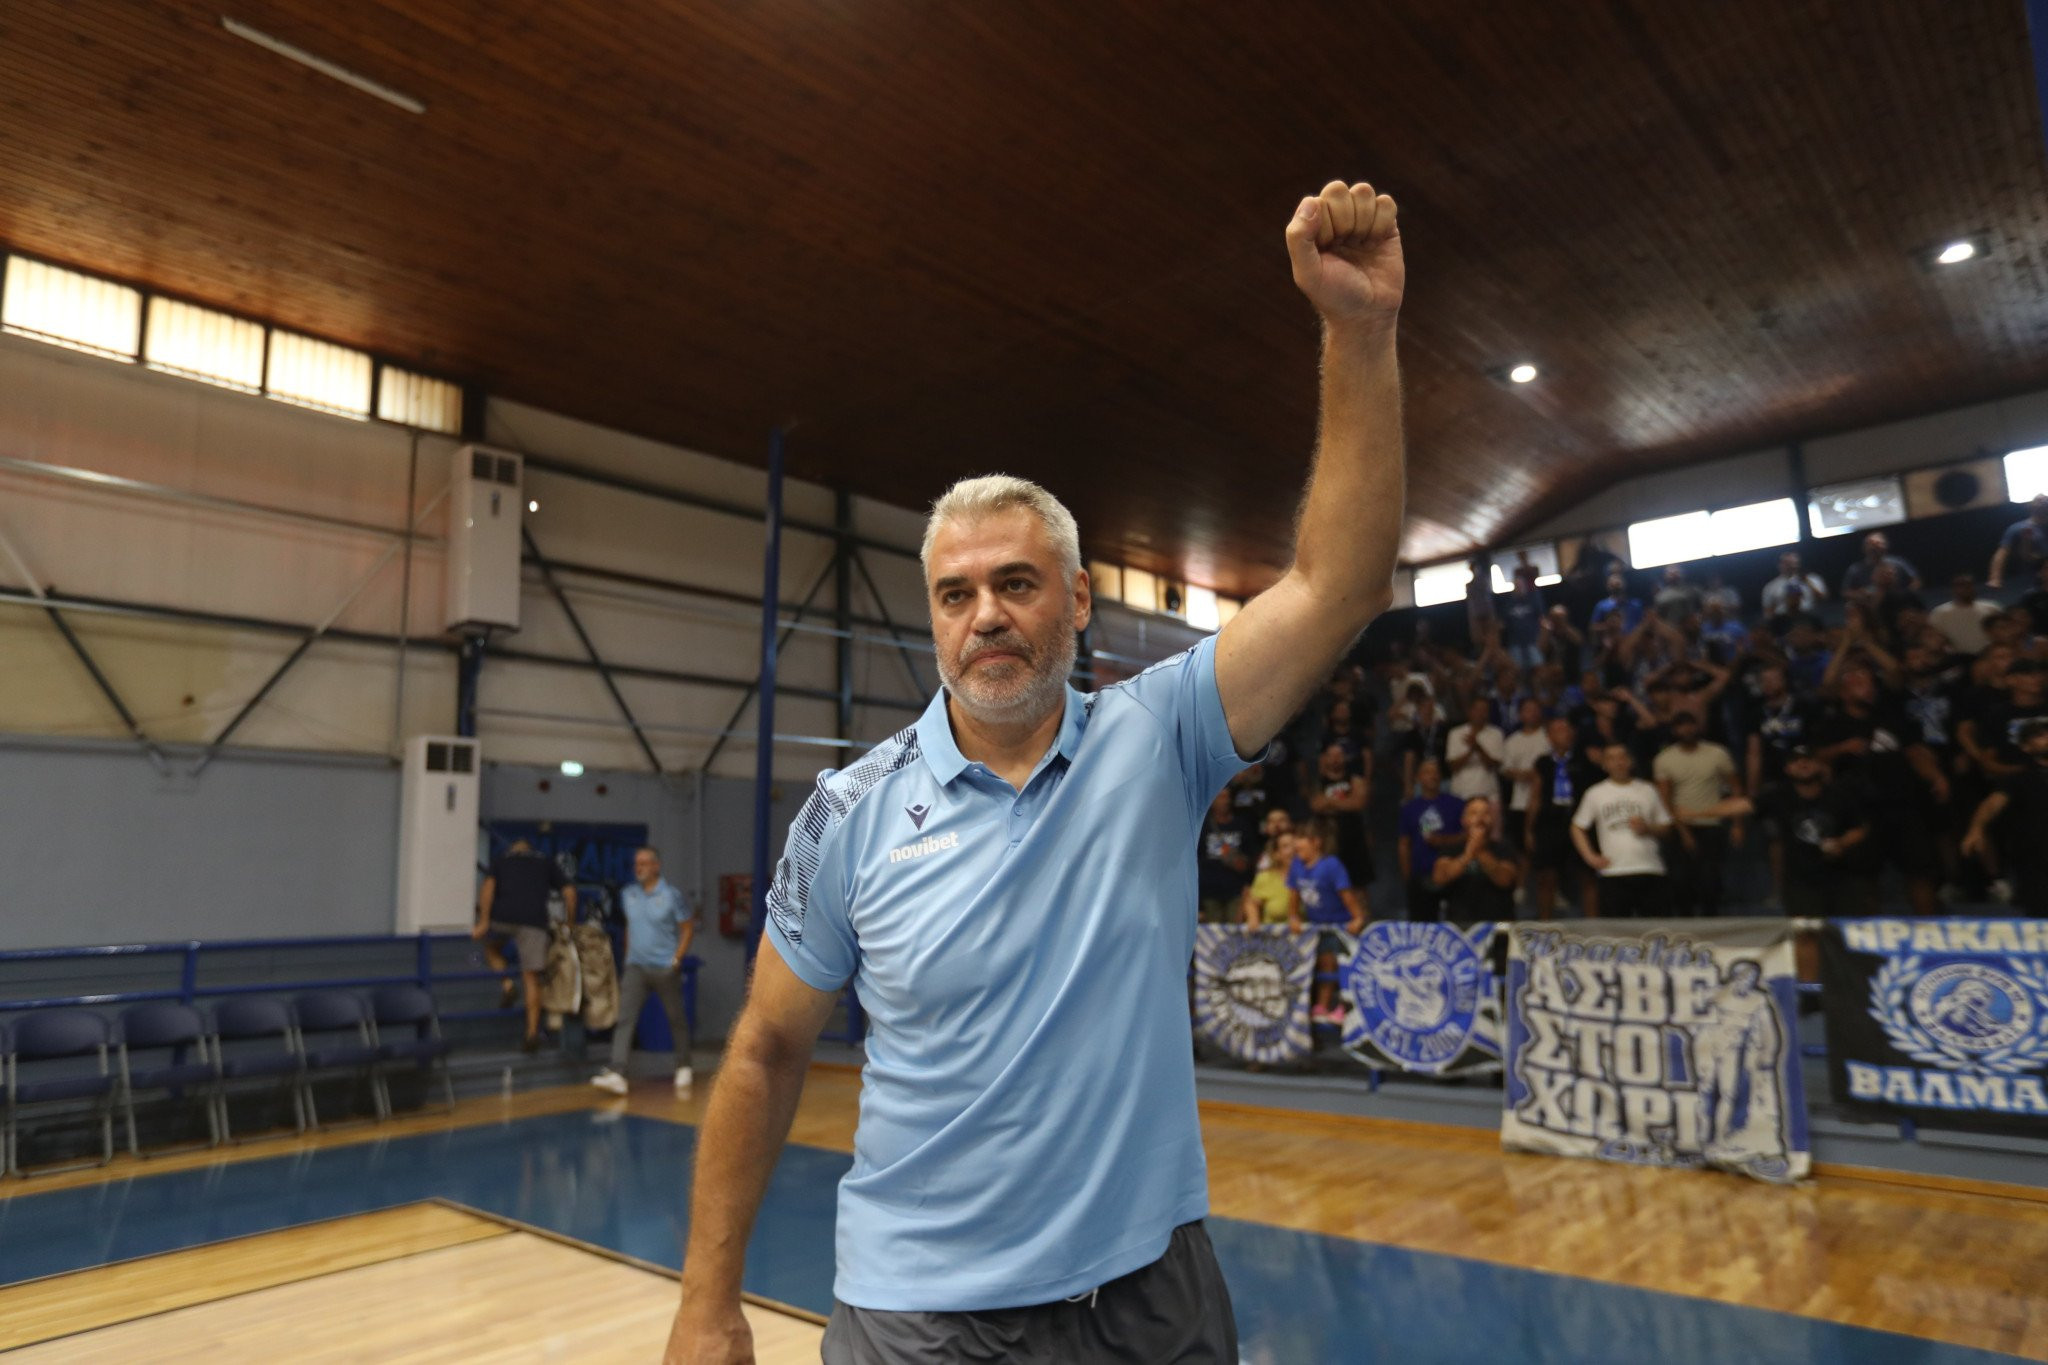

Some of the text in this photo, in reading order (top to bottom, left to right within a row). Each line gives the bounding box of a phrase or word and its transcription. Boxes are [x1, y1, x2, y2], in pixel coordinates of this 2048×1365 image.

[890, 832, 959, 863] novibet
[1387, 921, 1463, 963] ATHENS
[1524, 954, 1719, 1025] ΑΣΒΕ
[1524, 1007, 1663, 1086] ΣΤΟ
